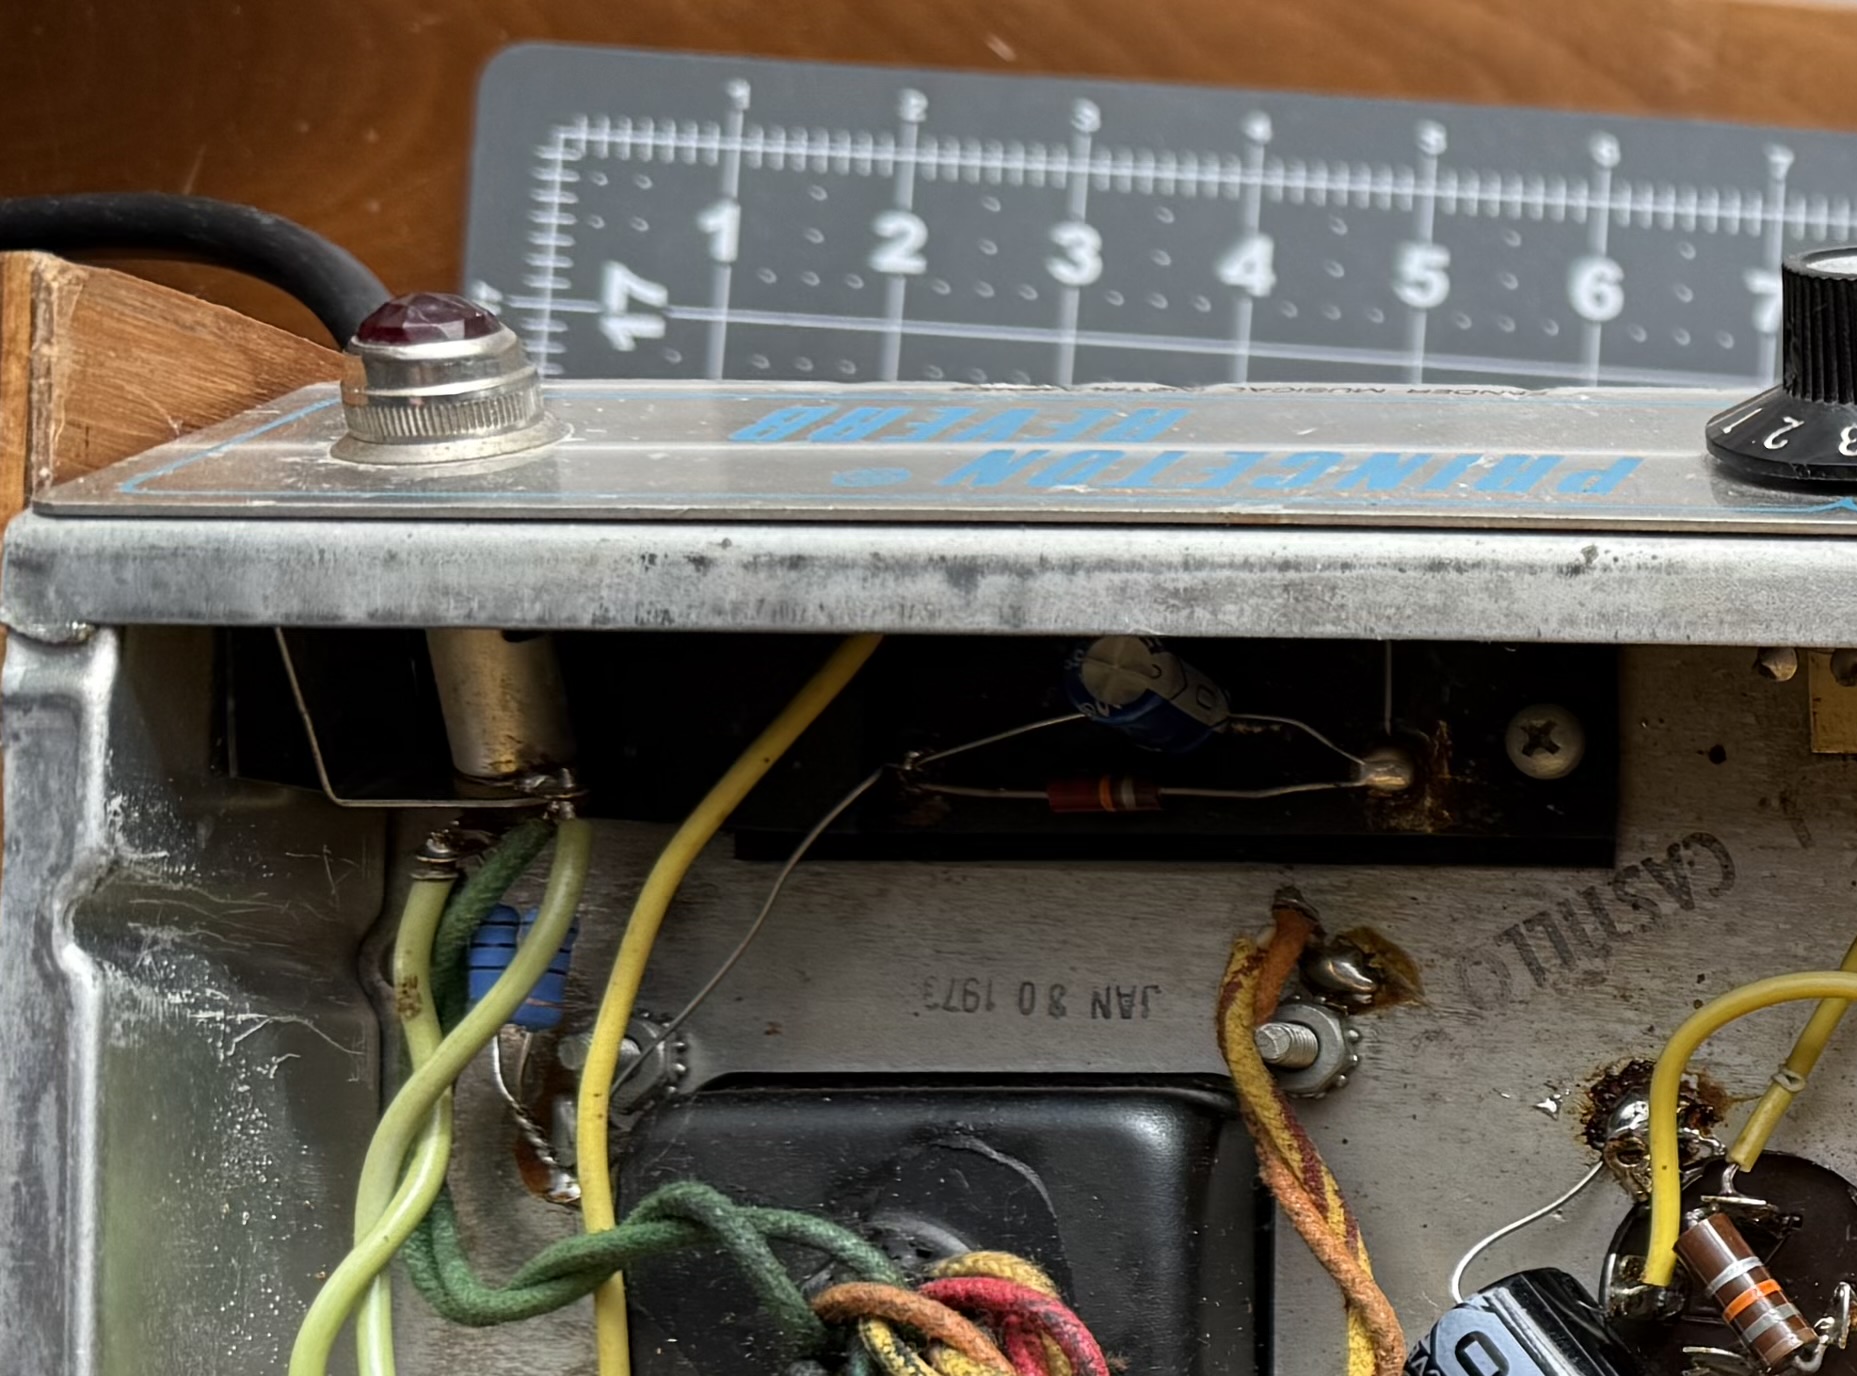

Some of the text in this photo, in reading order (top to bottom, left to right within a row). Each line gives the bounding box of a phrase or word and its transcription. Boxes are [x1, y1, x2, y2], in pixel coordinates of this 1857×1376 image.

[697, 199, 742, 262] 1
[868, 209, 930, 276] 2
[1045, 220, 1104, 288] 3
[1216, 231, 1278, 298] 4
[1393, 242, 1452, 309] 5
[1568, 255, 1626, 323] 6
[600, 259, 670, 353] 17
[729, 407, 1190, 441] REVERB
[1720, 406, 1764, 435] 1
[1763, 416, 1805, 450] 2
[940, 449, 1643, 493] PRINCETON
[1457, 830, 1738, 1014] CASTILLO
[1090, 984, 1162, 1020] JAN
